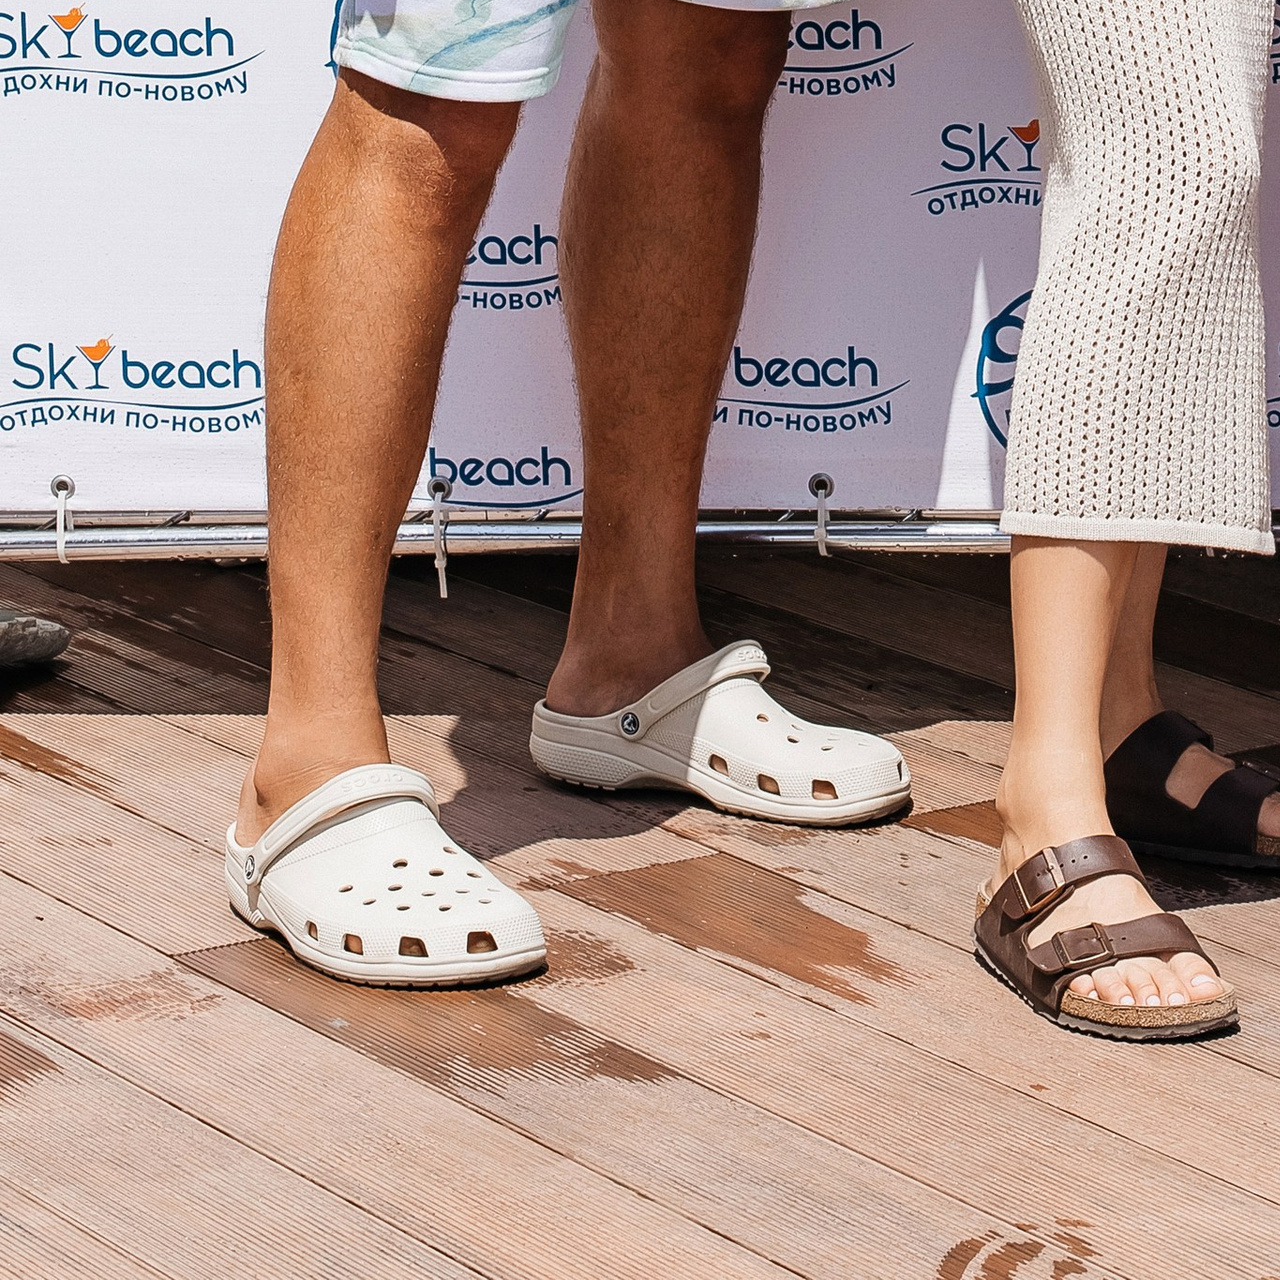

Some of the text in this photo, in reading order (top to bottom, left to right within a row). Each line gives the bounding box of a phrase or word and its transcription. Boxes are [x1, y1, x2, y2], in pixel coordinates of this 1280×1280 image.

[93, 16, 234, 58] beach
[787, 9, 883, 51] ach
[466, 223, 558, 266] ach
[121, 348, 262, 389] beach
[733, 345, 879, 388] beach
[428, 445, 572, 489] beach
